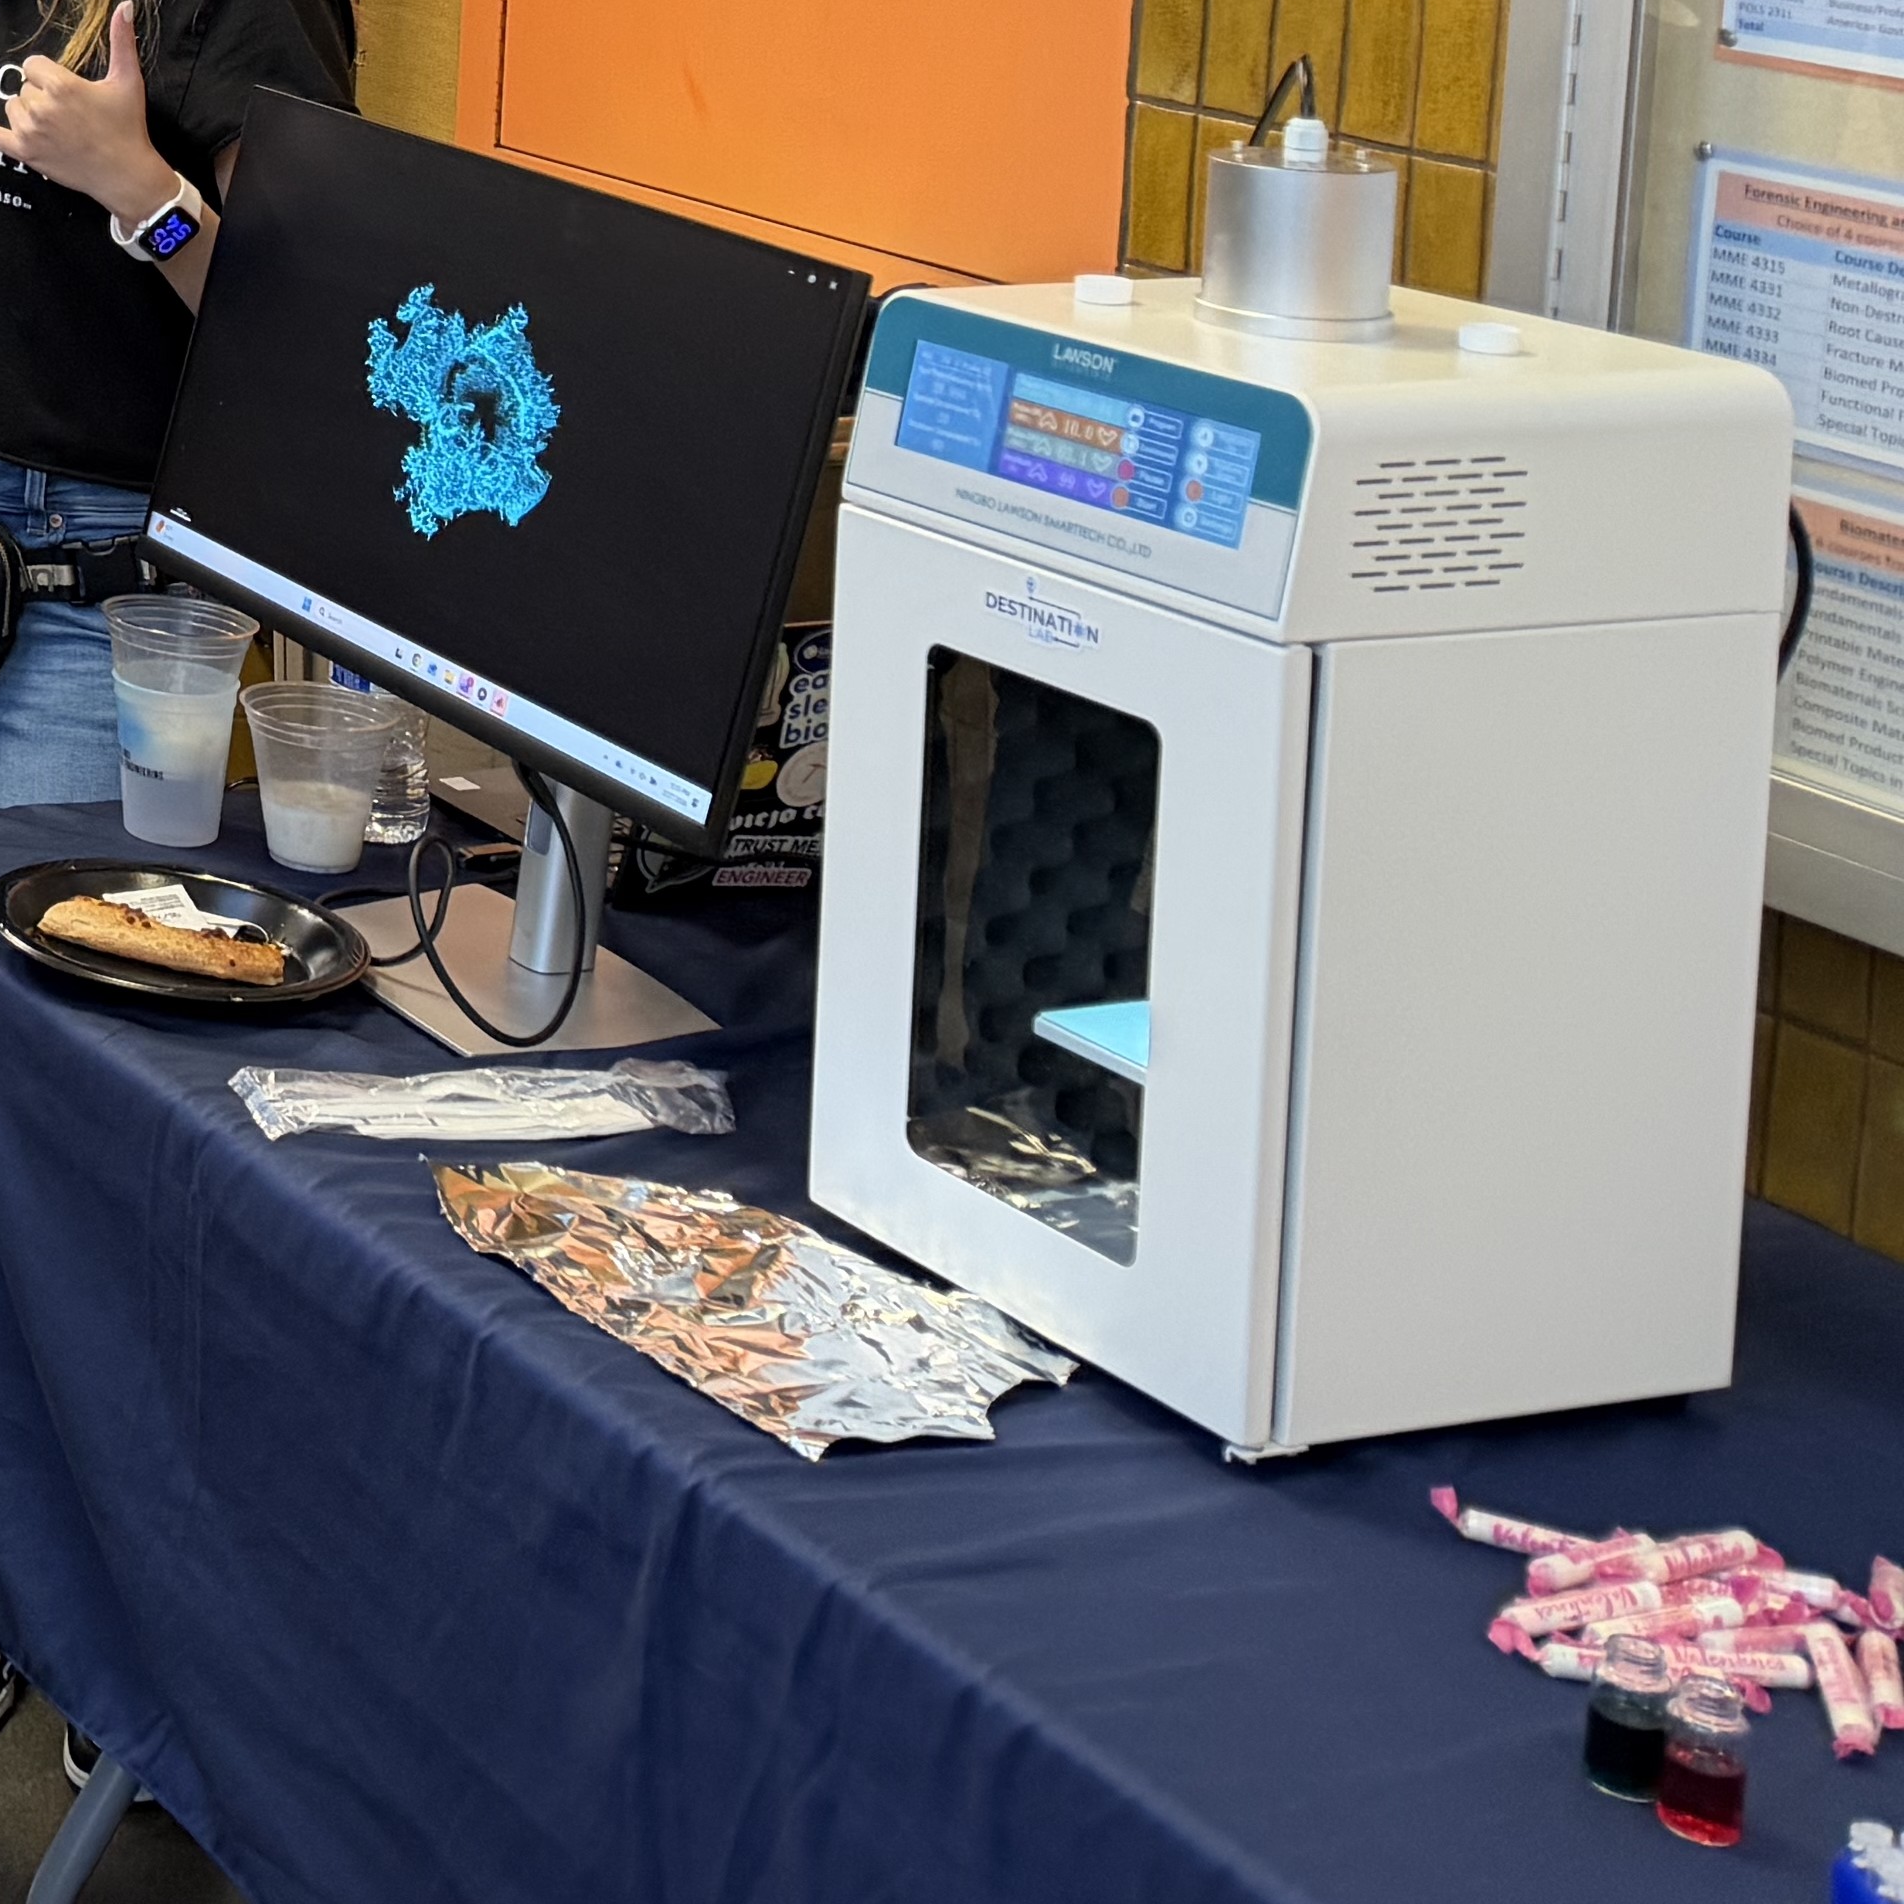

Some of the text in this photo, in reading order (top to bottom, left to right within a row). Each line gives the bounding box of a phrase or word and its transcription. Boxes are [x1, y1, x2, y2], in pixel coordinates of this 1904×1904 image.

[1739, 18, 1764, 31] Total
[1744, 184, 1888, 227] Forensic Engineering
[1776, 214, 1823, 234] Choice
[1826, 224, 1842, 238] of
[1713, 247, 1786, 275] MME 4315
[1714, 224, 1884, 274] Course Course
[1711, 270, 1783, 298] MME 4331
[1708, 292, 1743, 312] MME
[1747, 301, 1782, 321] 4332
[1828, 320, 1861, 339] Root
[1706, 315, 1884, 368] MME 4333 Fracture
[1053, 343, 1115, 374] LAWSON
[1704, 338, 1877, 392] MME 4334 Biomed
[1820, 390, 1894, 419] Functional
[1816, 414, 1867, 438] Special
[997, 499, 1042, 525] LAWSON
[1814, 561, 1855, 581] ourse
[986, 591, 1099, 644] DESTINATION
[1813, 586, 1904, 620] undamentals
[1811, 609, 1901, 644] undamentals
[1798, 648, 1854, 677] Polymer
[794, 675, 828, 694] ea
[1796, 671, 1882, 711] Biomaterials
[789, 694, 828, 720] sle
[1794, 695, 1868, 730] Composite
[784, 719, 827, 745] bio
[1793, 716, 1845, 745] Biomed
[1791, 740, 1839, 768] Special
[1843, 757, 1886, 785] Topics
[735, 838, 790, 855] TRUST
[716, 870, 808, 885] ENGINEER
